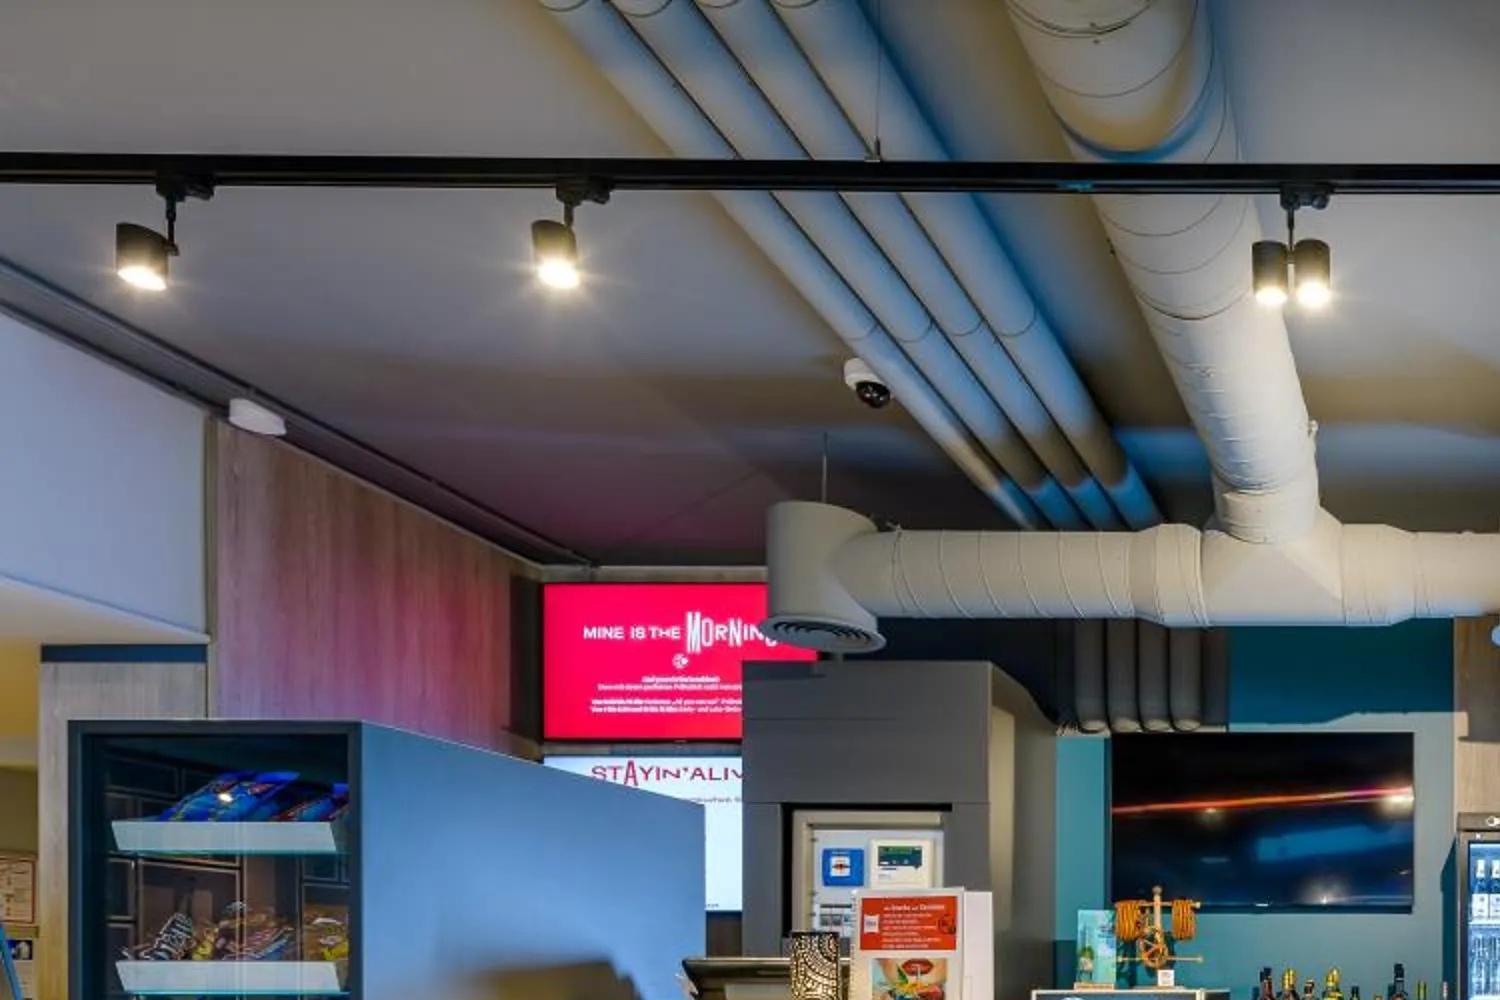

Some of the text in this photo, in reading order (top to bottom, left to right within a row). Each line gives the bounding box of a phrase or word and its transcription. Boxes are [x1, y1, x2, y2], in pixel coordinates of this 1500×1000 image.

[584, 626, 624, 639] MINE
[630, 626, 646, 639] IS
[651, 627, 681, 639] THE
